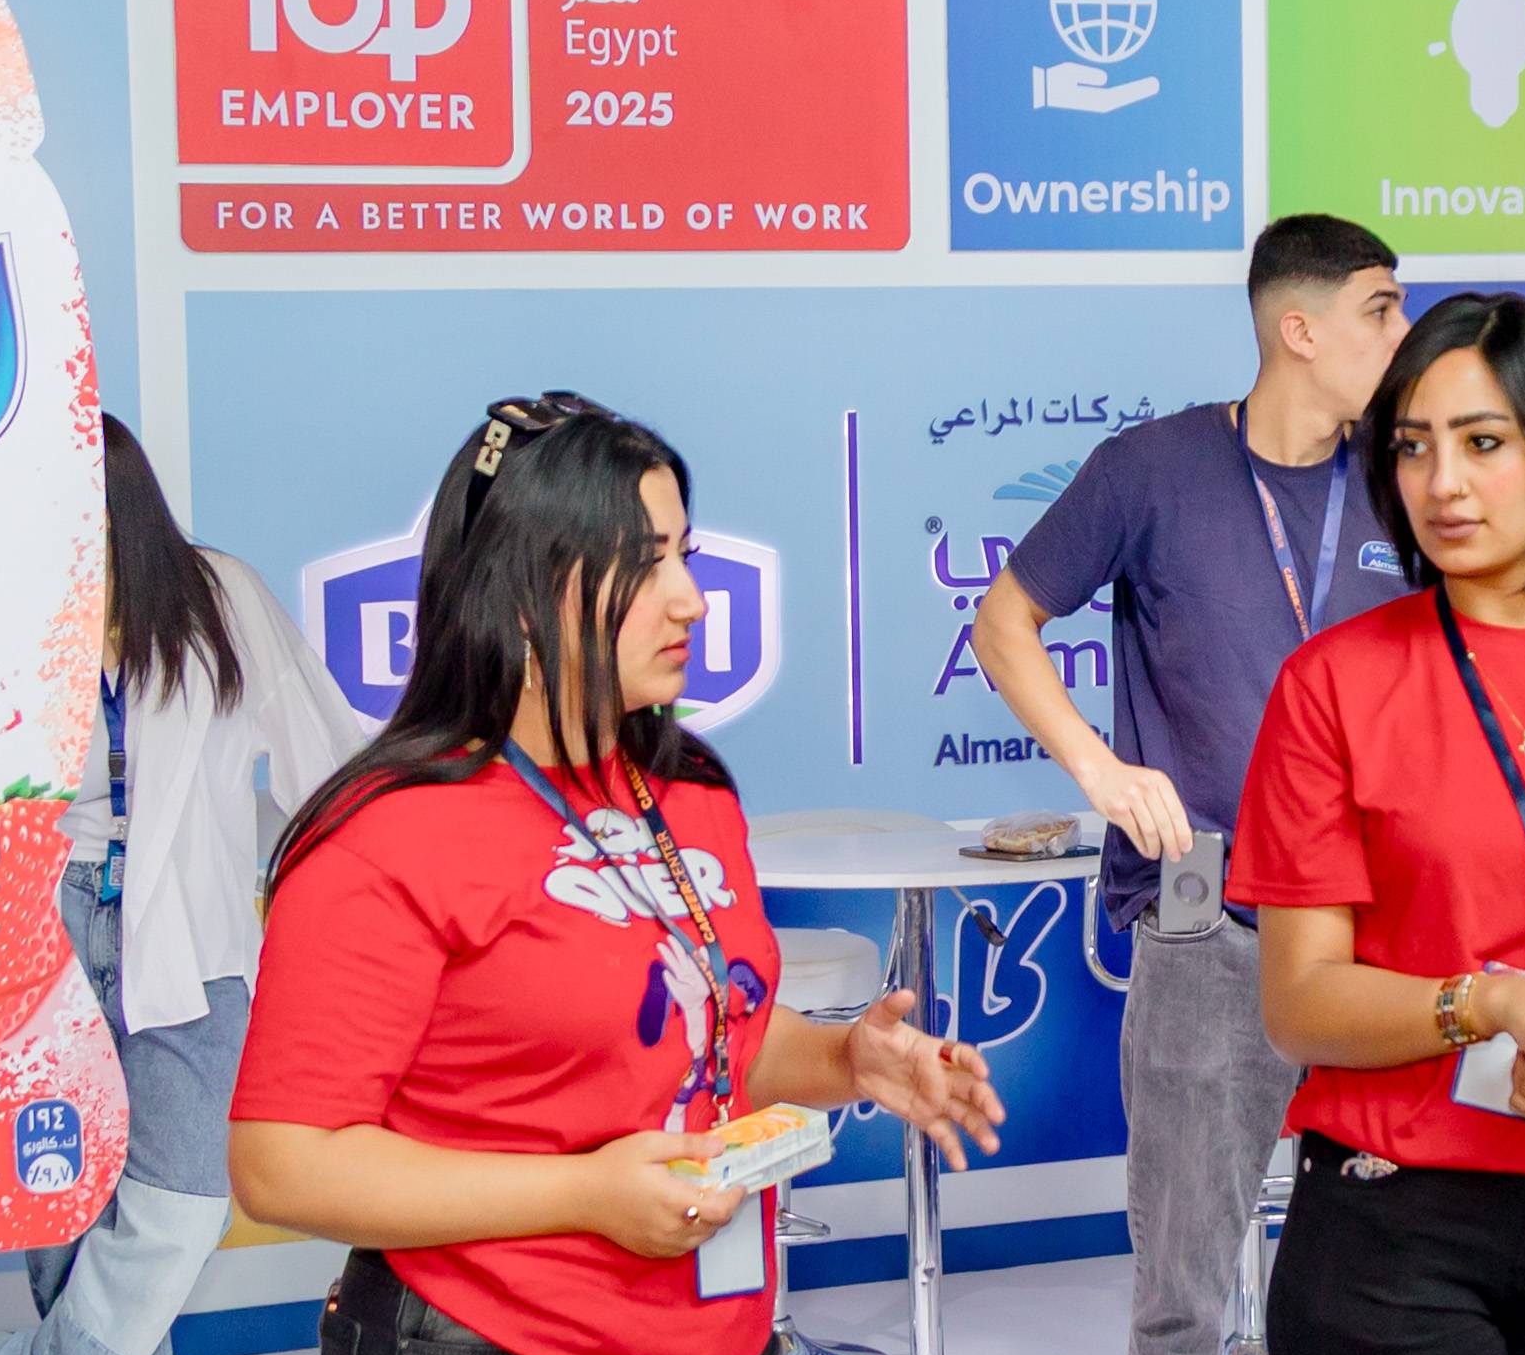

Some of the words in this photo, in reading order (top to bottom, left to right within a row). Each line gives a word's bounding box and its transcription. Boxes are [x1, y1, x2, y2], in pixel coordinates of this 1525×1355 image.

[565, 19, 678, 67] Egypt
[220, 90, 475, 131] EMPLOYER
[565, 91, 674, 128] 2025
[216, 201, 294, 231] FOR
[315, 202, 340, 231] A
[362, 202, 502, 231] BETTER
[522, 202, 666, 232] WORLD
[685, 203, 735, 232] OF
[754, 203, 870, 232] WORK
[963, 168, 1231, 222] Ownership
[929, 396, 1033, 444] المراعي
